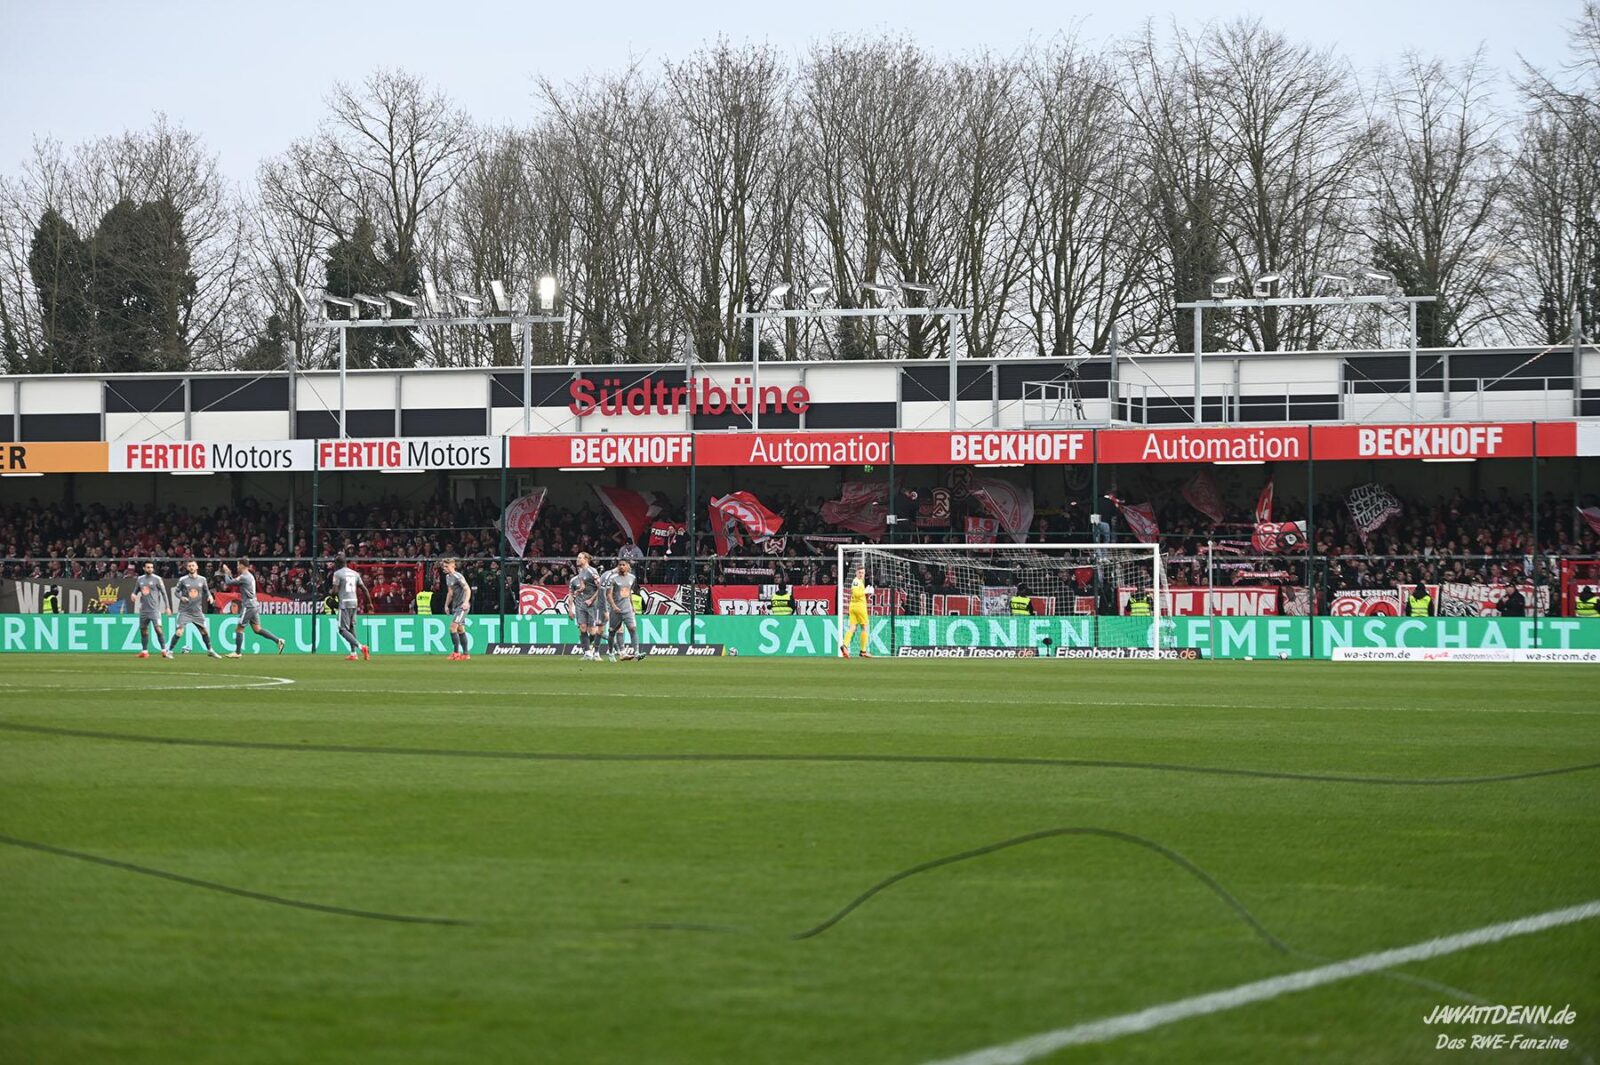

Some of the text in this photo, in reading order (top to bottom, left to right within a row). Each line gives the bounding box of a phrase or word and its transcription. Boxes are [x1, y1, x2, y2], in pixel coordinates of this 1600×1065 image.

[569, 378, 810, 416] Südtribüne
[570, 435, 895, 464] BECKHOFF Automation
[950, 431, 1299, 461] BECKHOFF Automation
[1359, 427, 1503, 456] BECKHOFF
[127, 444, 292, 469] FERTIG Motors
[320, 441, 490, 468] FERTIG Motors
[15, 581, 83, 614] WLD
[1362, 589, 1398, 597] ESSENER
[493, 645, 556, 655] bwin bwin
[1147, 619, 1580, 656] GEMEINSCHAFT
[650, 645, 679, 655] bwin
[686, 645, 715, 656] bwin
[898, 647, 1034, 658] Eisenbach Tresore.de
[1056, 647, 1126, 659] Eisenbach
[1344, 650, 1411, 659] wa-strom.de
[1526, 652, 1597, 661] wa-strom.de
